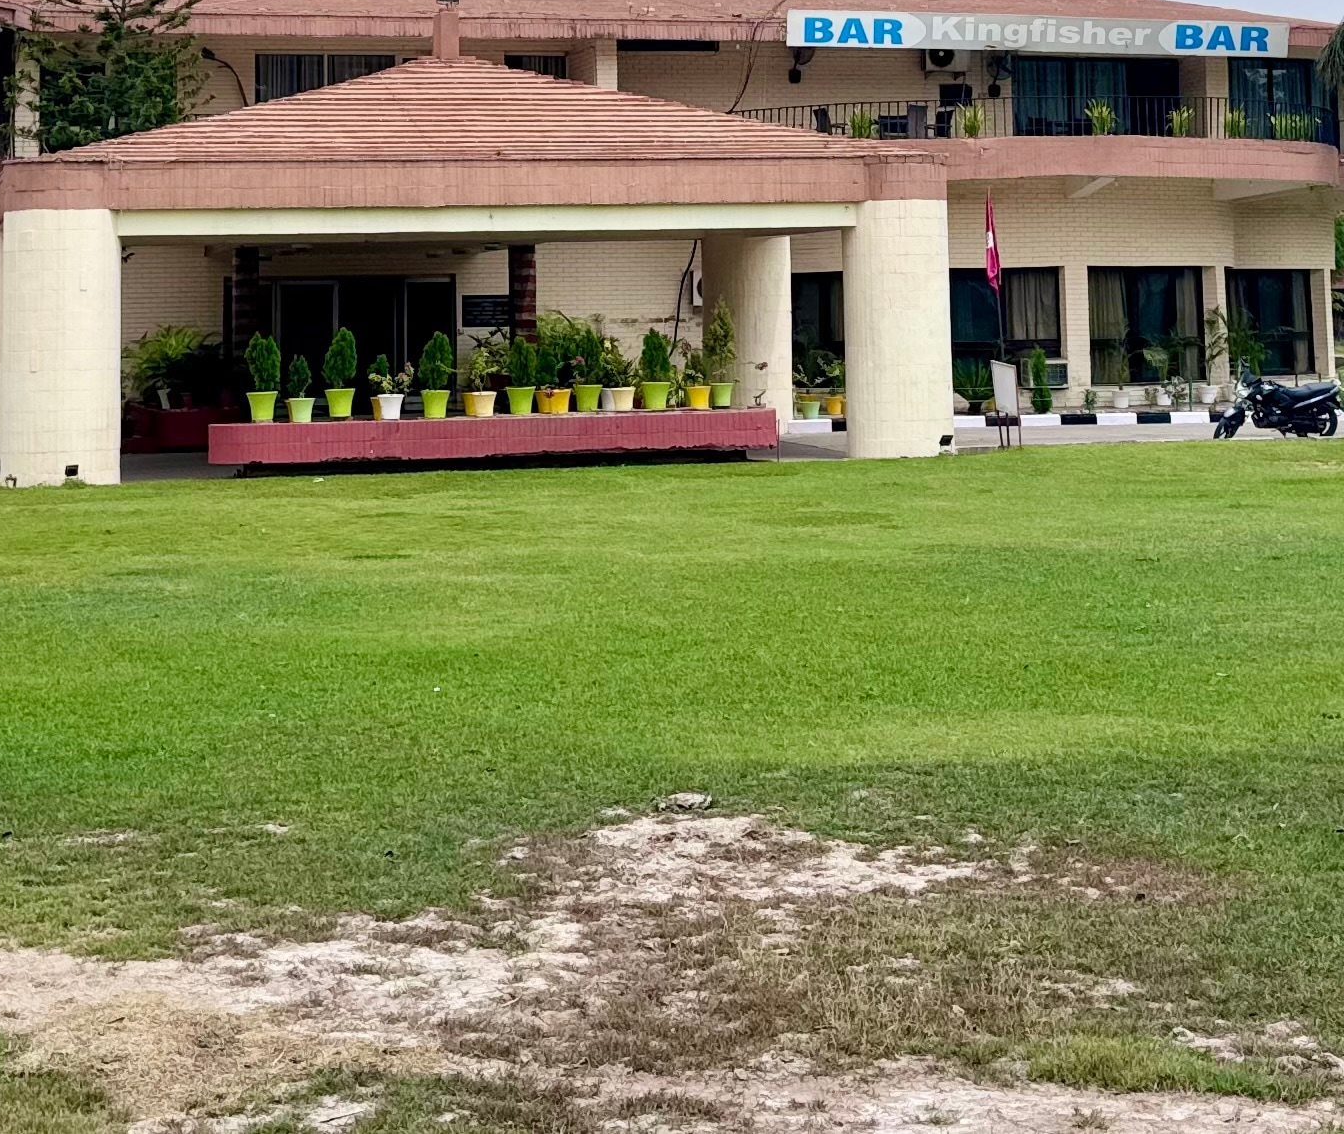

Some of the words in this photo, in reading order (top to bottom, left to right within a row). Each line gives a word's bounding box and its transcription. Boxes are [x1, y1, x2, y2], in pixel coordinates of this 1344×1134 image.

[804, 17, 903, 45] BAR
[931, 16, 1152, 48] Kingfisher
[1175, 24, 1269, 52] BAR
